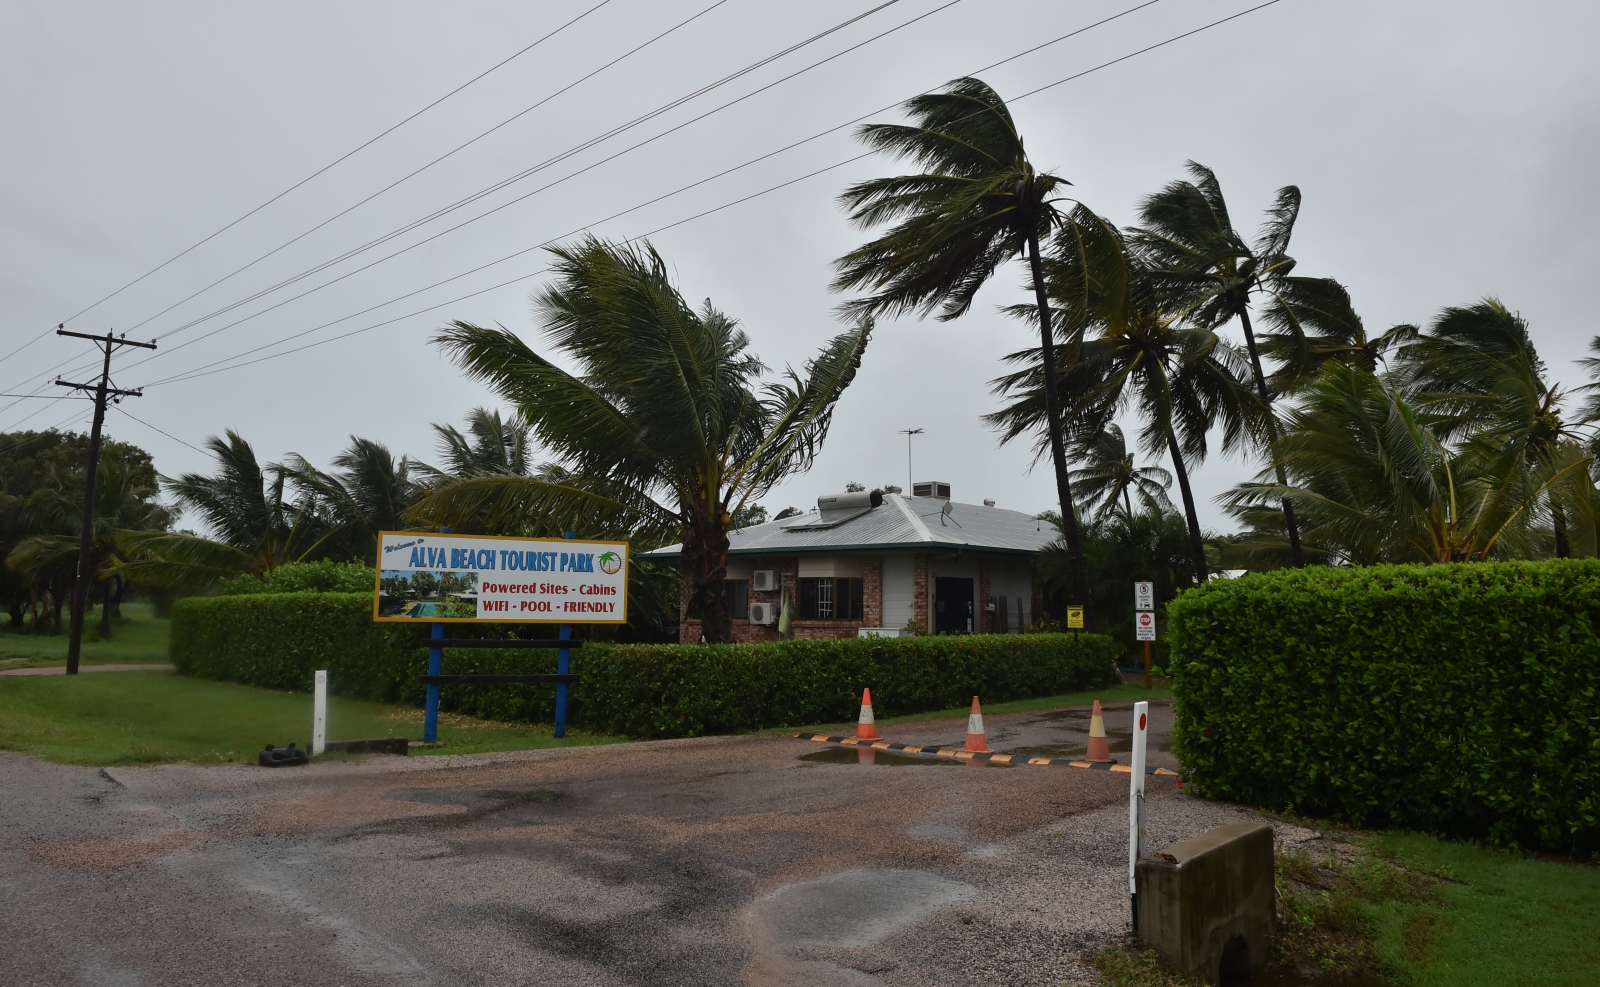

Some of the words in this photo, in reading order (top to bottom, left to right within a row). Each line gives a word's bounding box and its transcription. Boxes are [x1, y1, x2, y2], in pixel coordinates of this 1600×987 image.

[384, 541, 416, 553] Welcome
[409, 546, 447, 568] ALVA
[450, 548, 496, 570] BEACH
[500, 550, 557, 571] TOURIST
[560, 552, 594, 573] PARK
[482, 582, 536, 594] Powered
[539, 583, 568, 594] Sites
[579, 584, 617, 596] Cabins
[483, 600, 509, 611] WIFI
[520, 601, 552, 612] POOL
[563, 601, 616, 613] FRIENDLY
